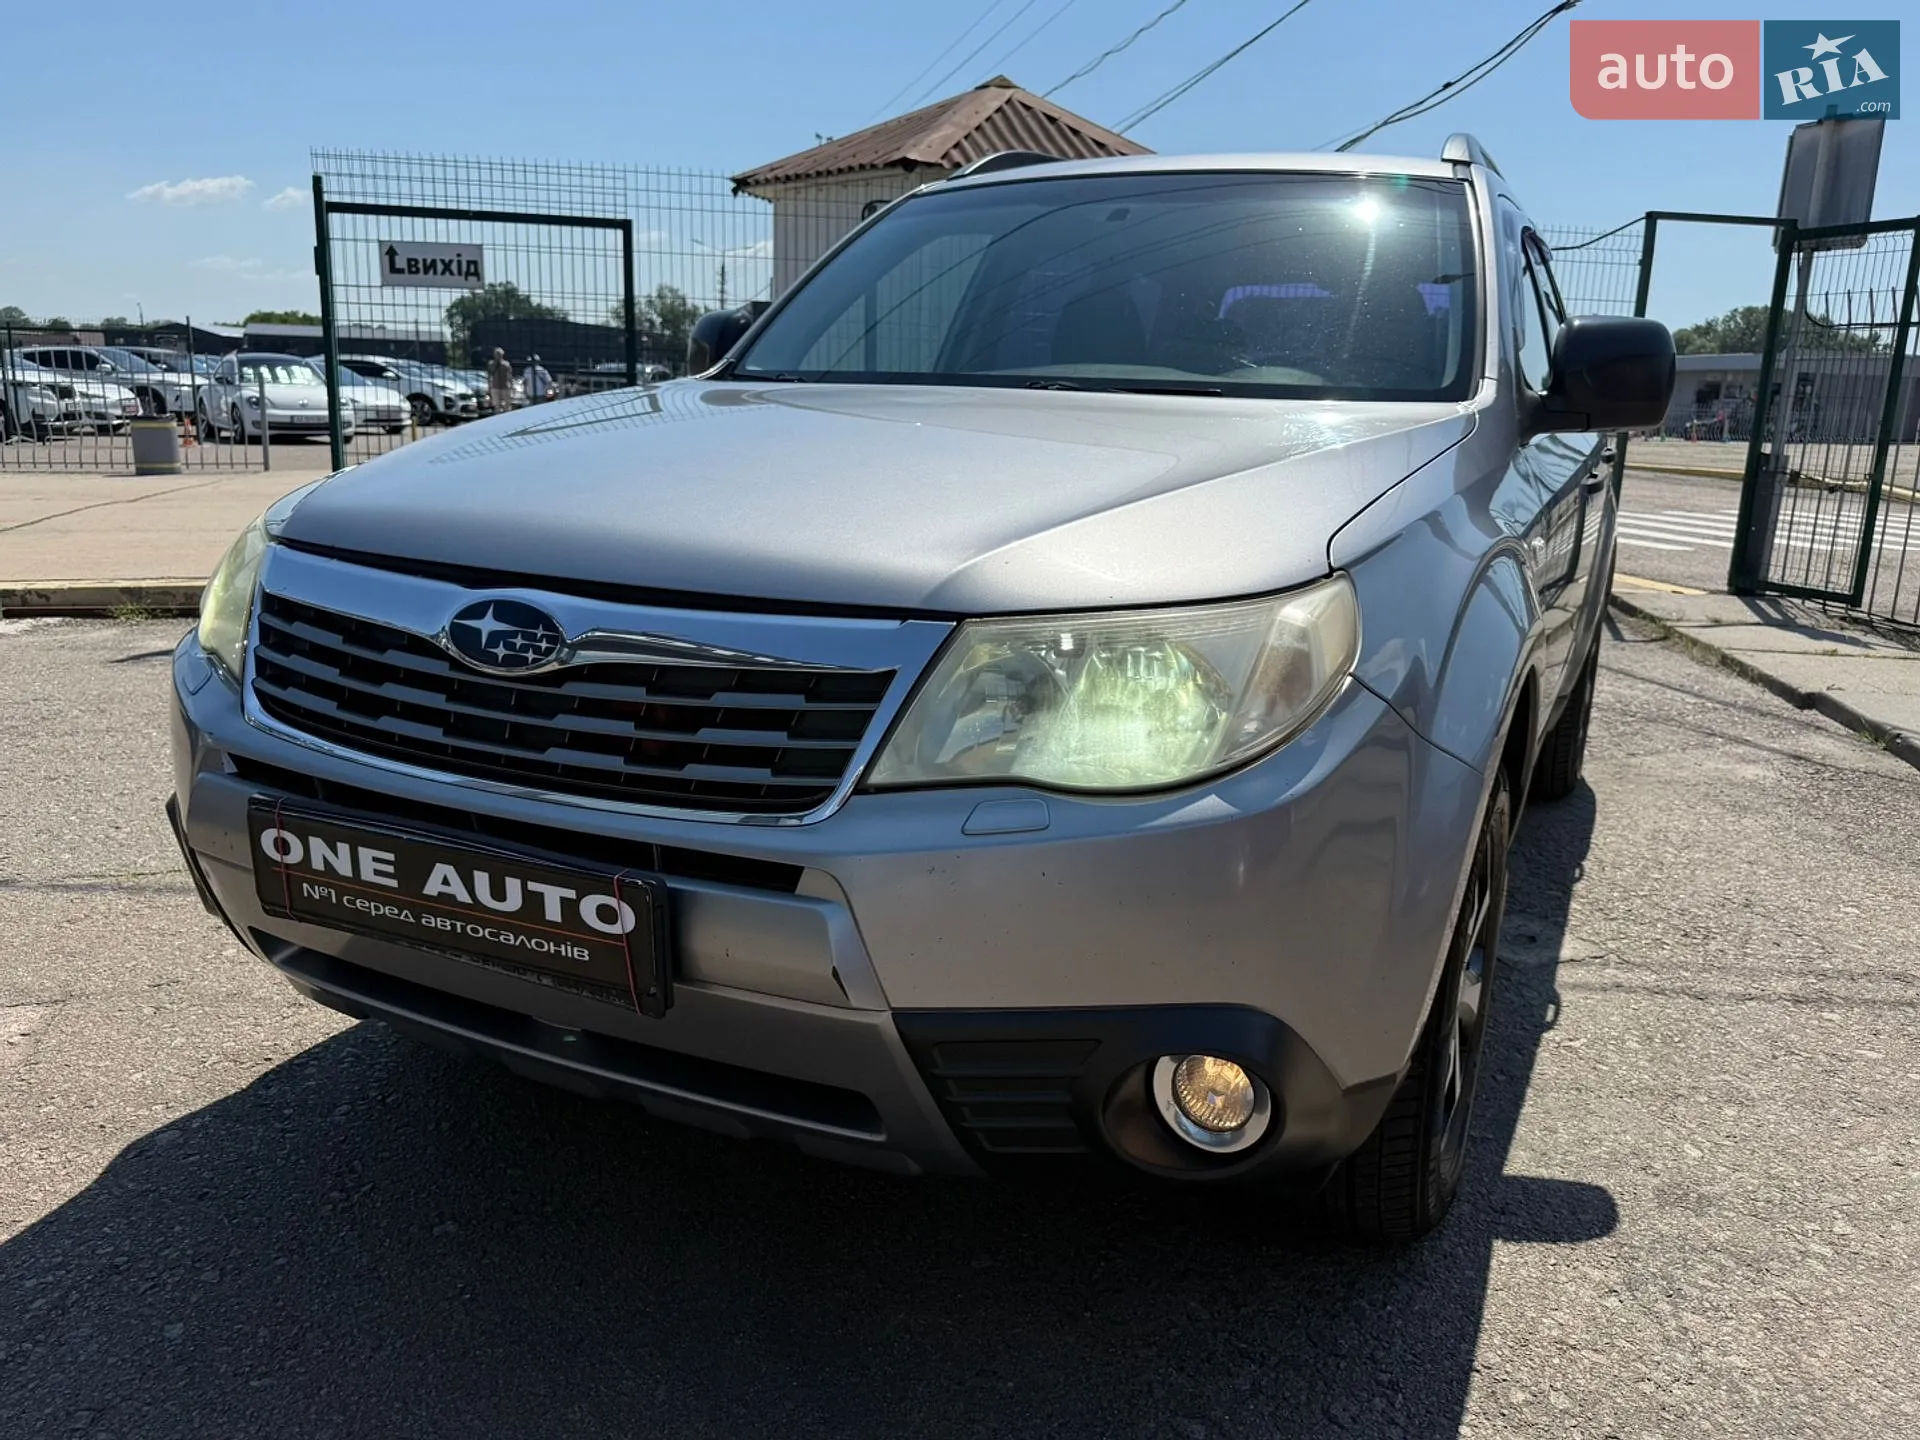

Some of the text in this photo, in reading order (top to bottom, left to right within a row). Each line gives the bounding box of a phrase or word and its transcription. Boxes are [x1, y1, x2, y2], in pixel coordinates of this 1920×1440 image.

[406, 253, 480, 282] вихід
[260, 828, 636, 935] ONE AUTO
[343, 895, 415, 923] серед
[421, 913, 590, 962] автосалонів
